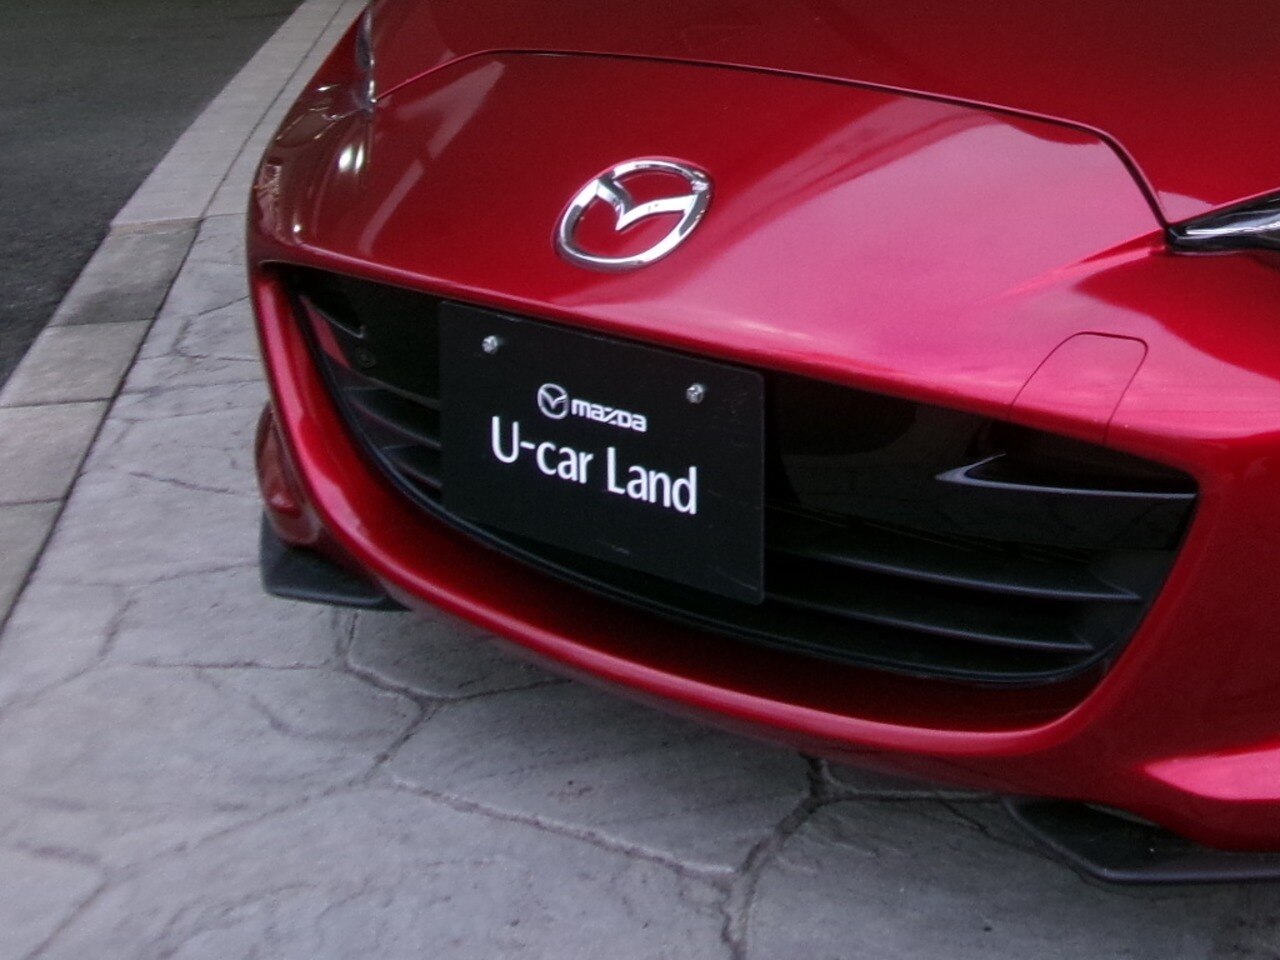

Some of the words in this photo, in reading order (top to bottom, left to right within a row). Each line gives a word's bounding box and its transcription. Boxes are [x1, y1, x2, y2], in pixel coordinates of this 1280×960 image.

[570, 398, 648, 433] mazda
[491, 415, 594, 485] U-car
[607, 446, 698, 515] Land
